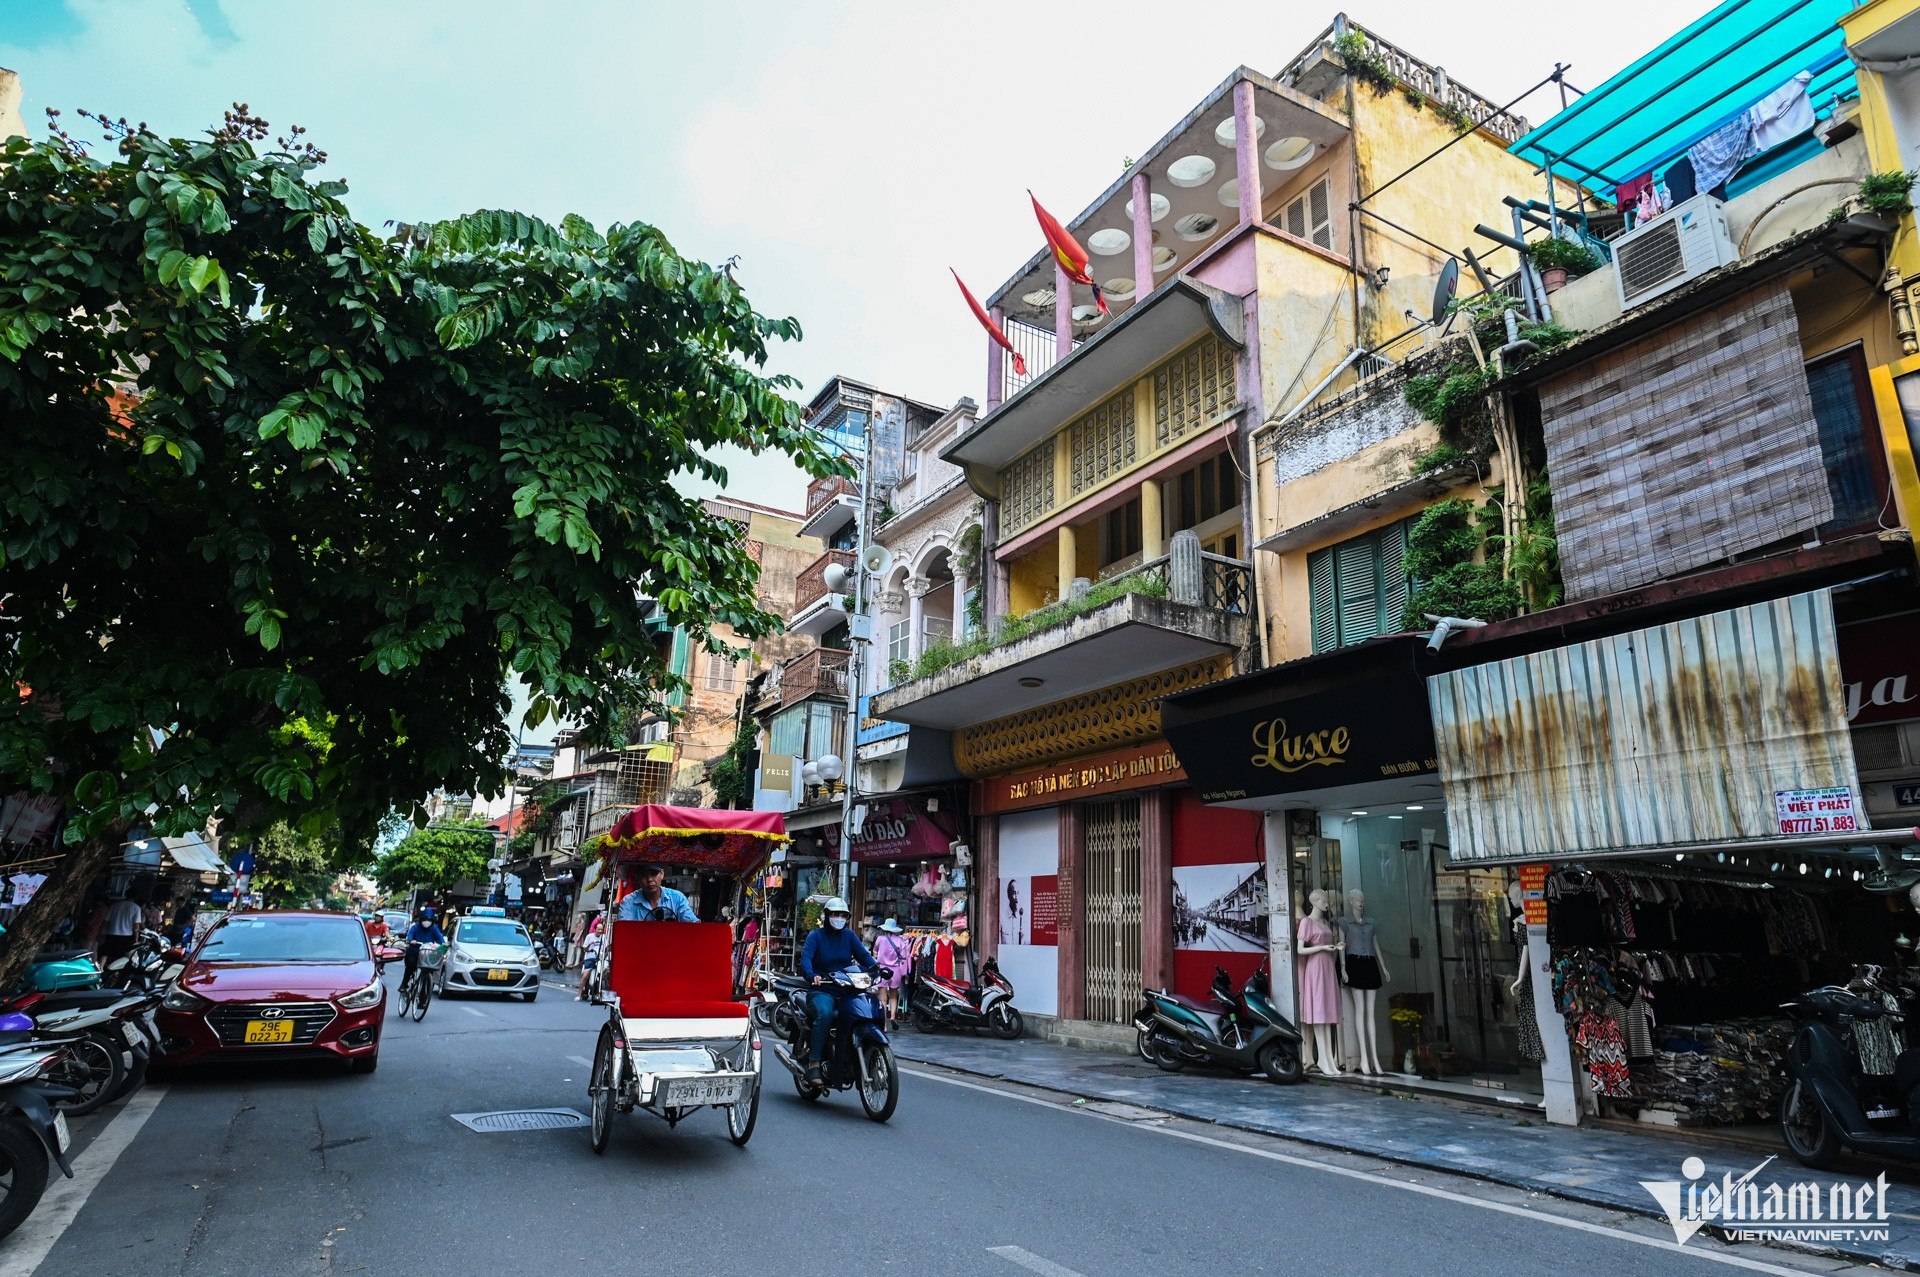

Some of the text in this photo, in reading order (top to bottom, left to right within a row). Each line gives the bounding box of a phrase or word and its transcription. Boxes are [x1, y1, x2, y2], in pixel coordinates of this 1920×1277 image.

[1251, 717, 1350, 773] Luxe
[766, 768, 790, 777] FELIZ
[1380, 763, 1399, 775] BÁN
[1398, 760, 1420, 773] BUÔN
[1030, 774, 1044, 796] HỒ
[1045, 773, 1057, 793] VÀ
[1059, 768, 1080, 791] NỀN
[1081, 765, 1103, 788] ĐỘC
[1105, 760, 1128, 784] LẬP
[1130, 755, 1156, 777] DÂN
[1787, 798, 1851, 814] VIỆT PHÁT
[875, 816, 906, 841] ĐÀO
[1780, 815, 1854, 833] 09777.51.883
[260, 1022, 281, 1031] 29E
[250, 1032, 287, 1042] 022.37
[675, 1086, 733, 1099] 29XL-0178
